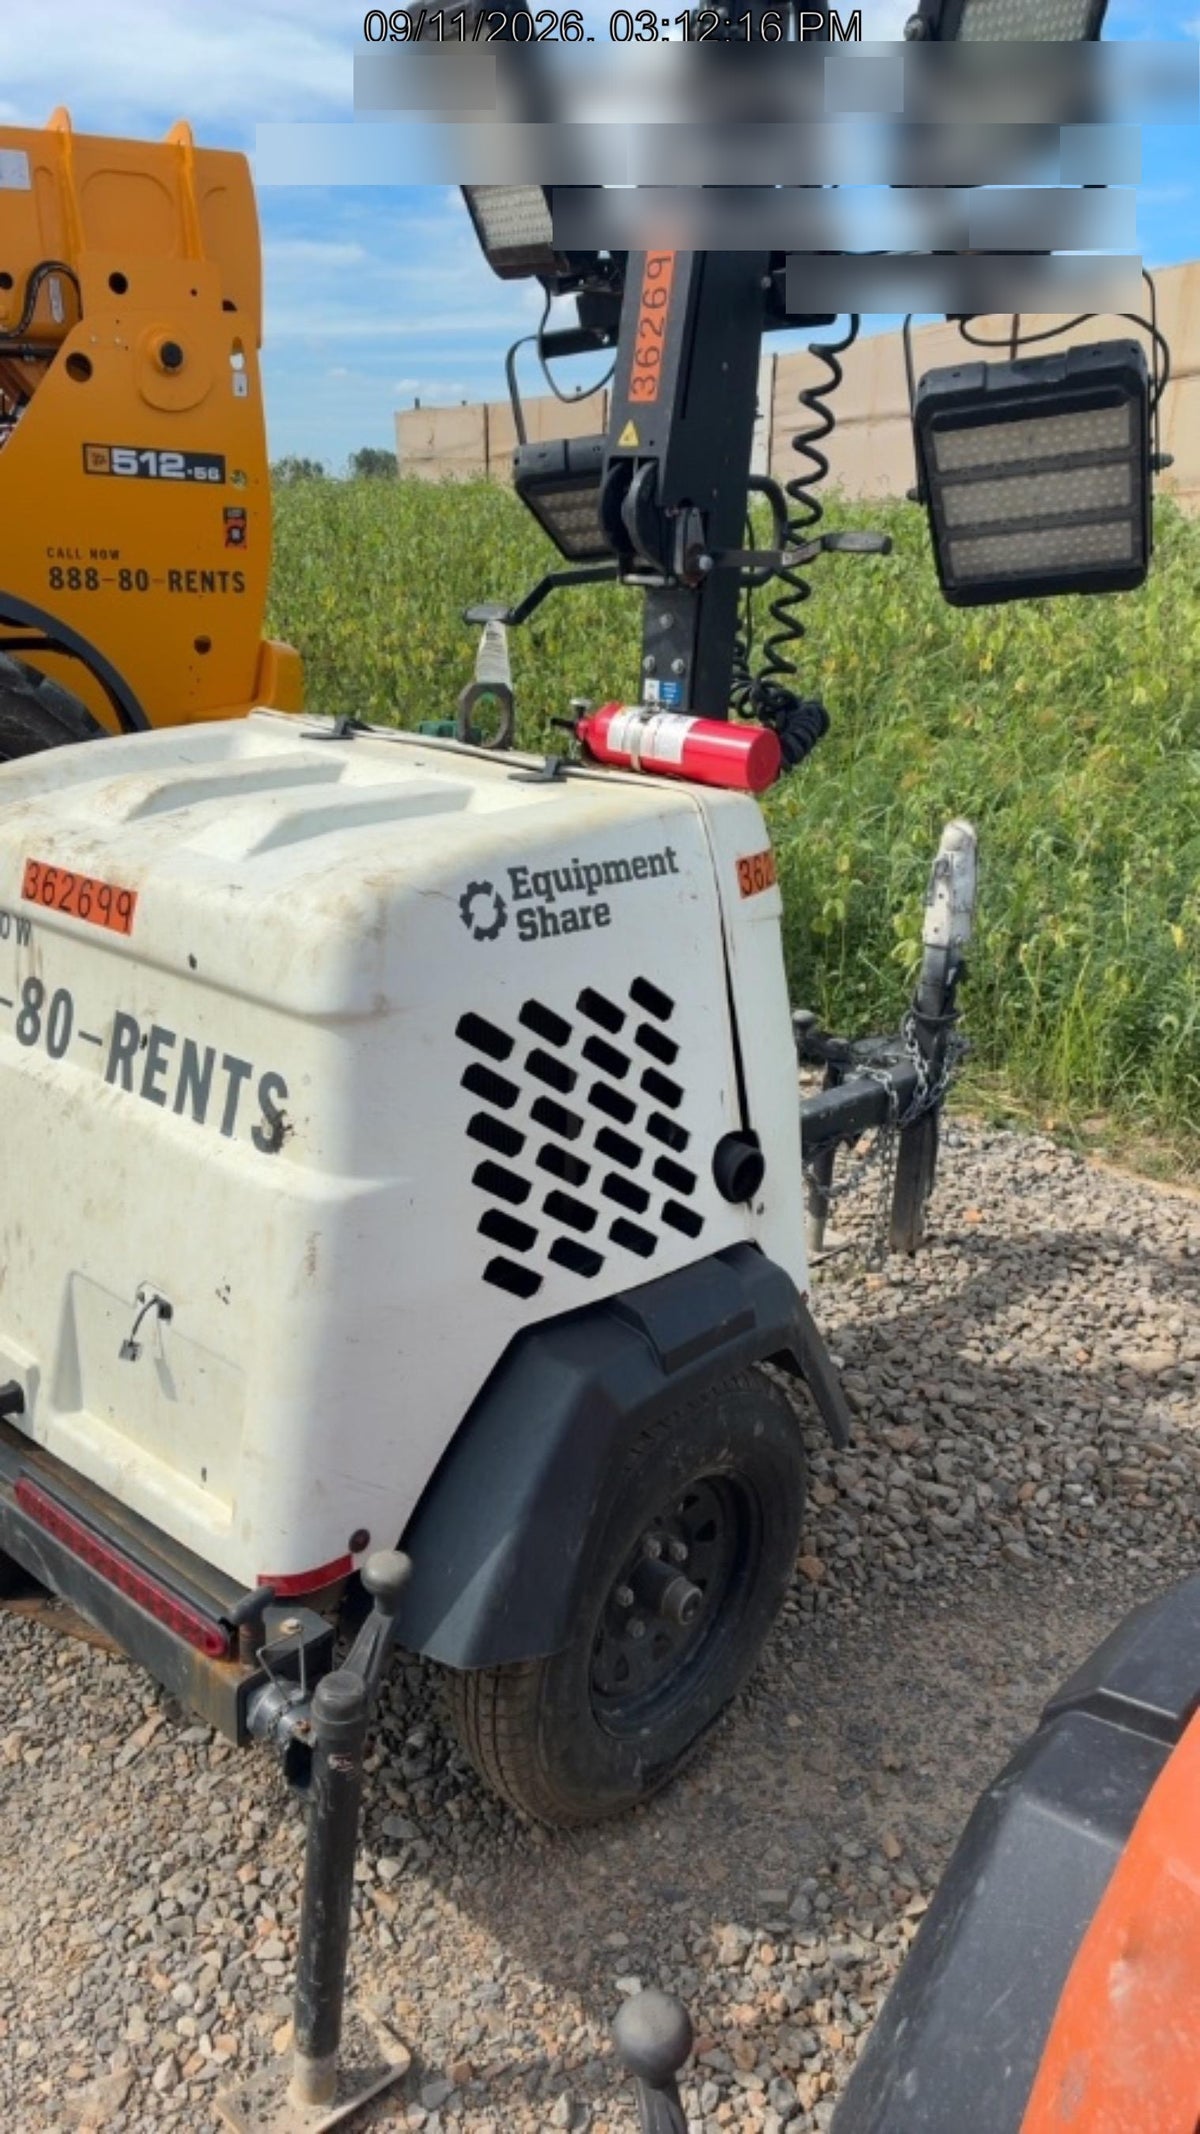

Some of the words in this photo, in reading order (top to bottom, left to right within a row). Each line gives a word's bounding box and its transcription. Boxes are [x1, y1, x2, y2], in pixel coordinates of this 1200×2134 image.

[47, 547, 82, 559] CALL
[90, 548, 120, 560] NOW
[49, 566, 245, 593] 888-80-RENTS
[507, 846, 680, 903] Equipment
[24, 861, 132, 933] 362699
[516, 902, 612, 942] Share
